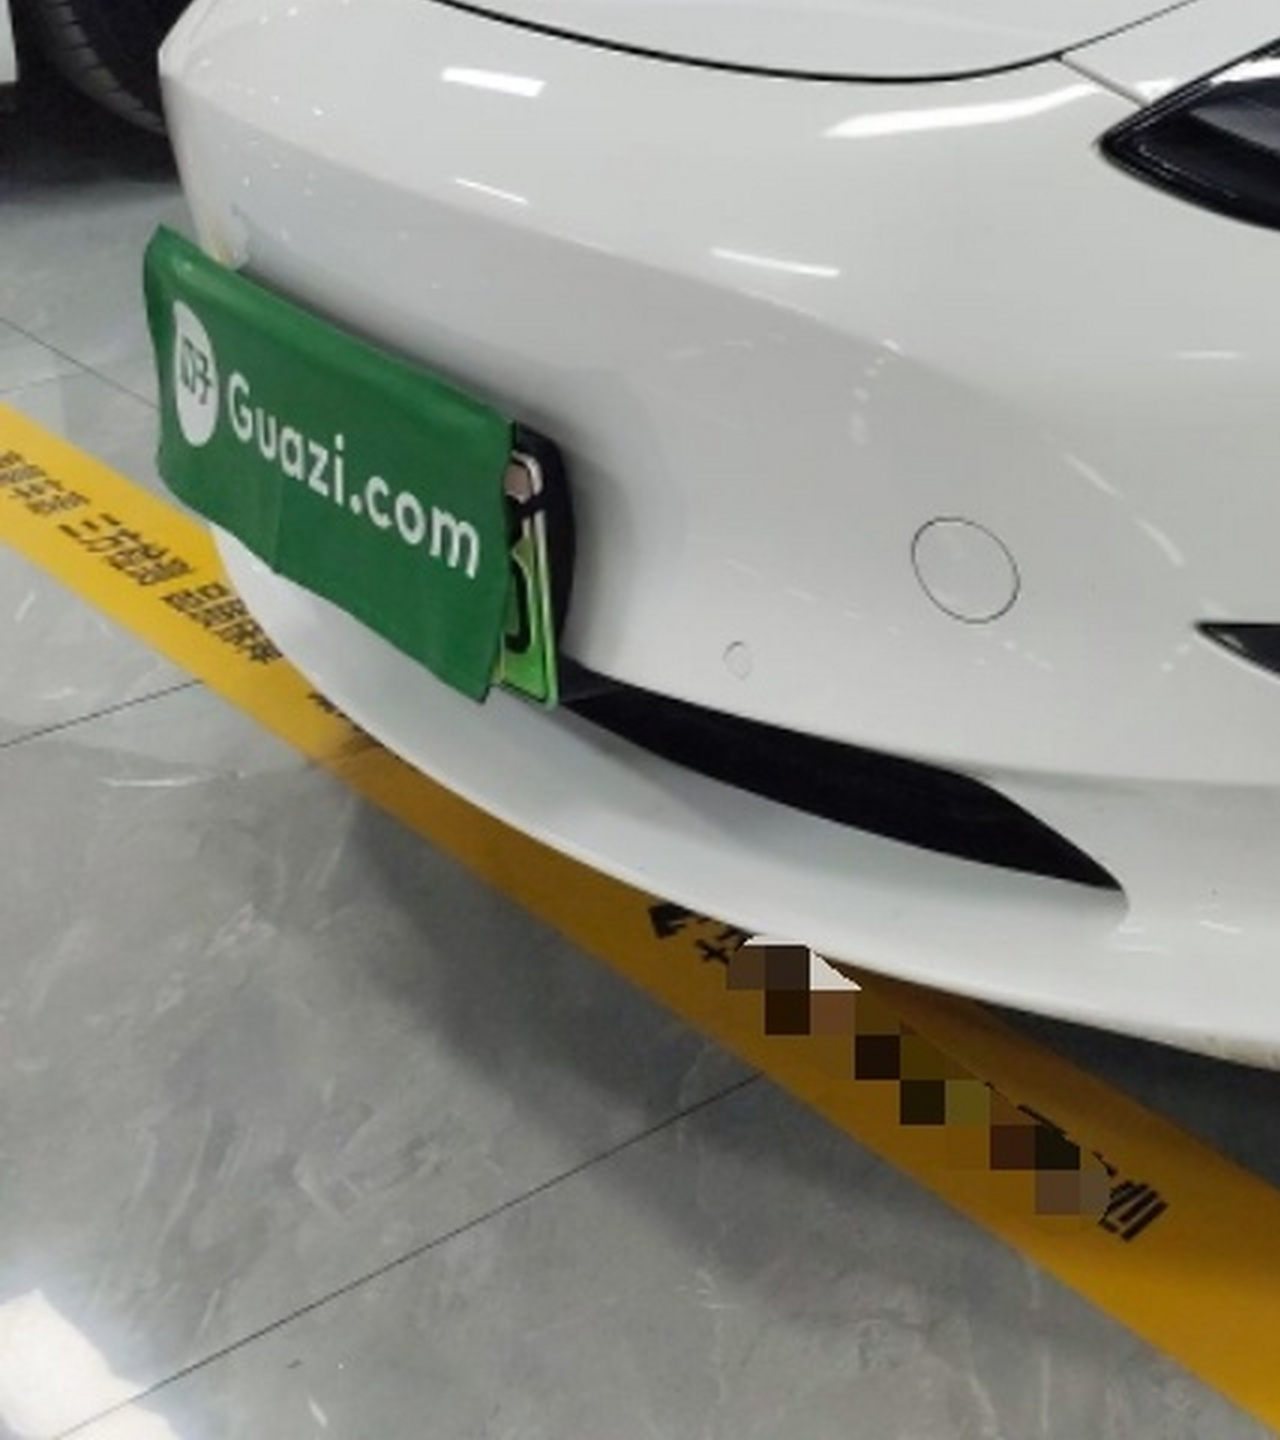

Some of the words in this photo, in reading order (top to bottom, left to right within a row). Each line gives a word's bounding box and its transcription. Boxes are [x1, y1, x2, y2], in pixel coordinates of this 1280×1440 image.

[228, 372, 480, 579] Guazi.com
[58, 512, 190, 586] 三方检测
